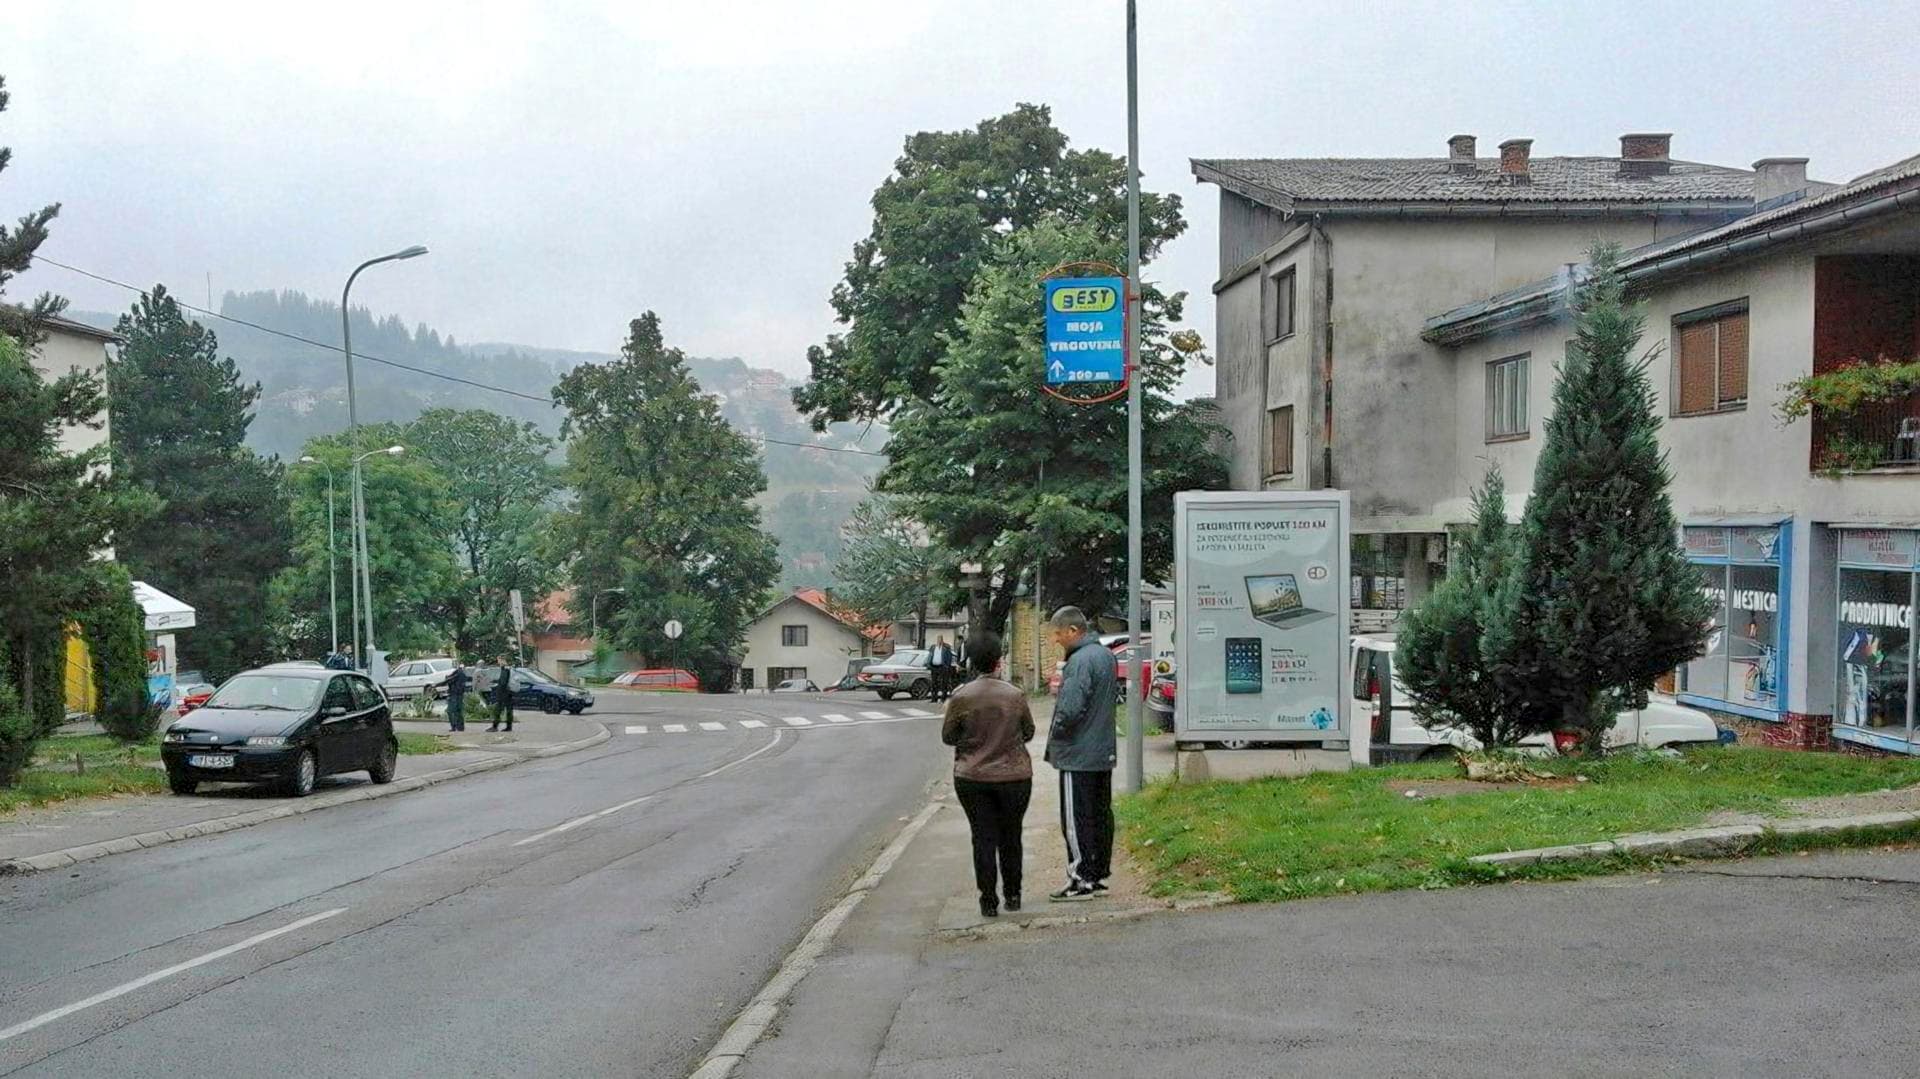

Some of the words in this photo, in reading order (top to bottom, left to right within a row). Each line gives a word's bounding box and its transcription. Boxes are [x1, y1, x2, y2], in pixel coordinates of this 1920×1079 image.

[1063, 290, 1109, 309] BEST
[1066, 321, 1103, 333] MOJA
[1050, 341, 1121, 352] TRGOVINA
[1841, 600, 1912, 628] PRODAVNICA
